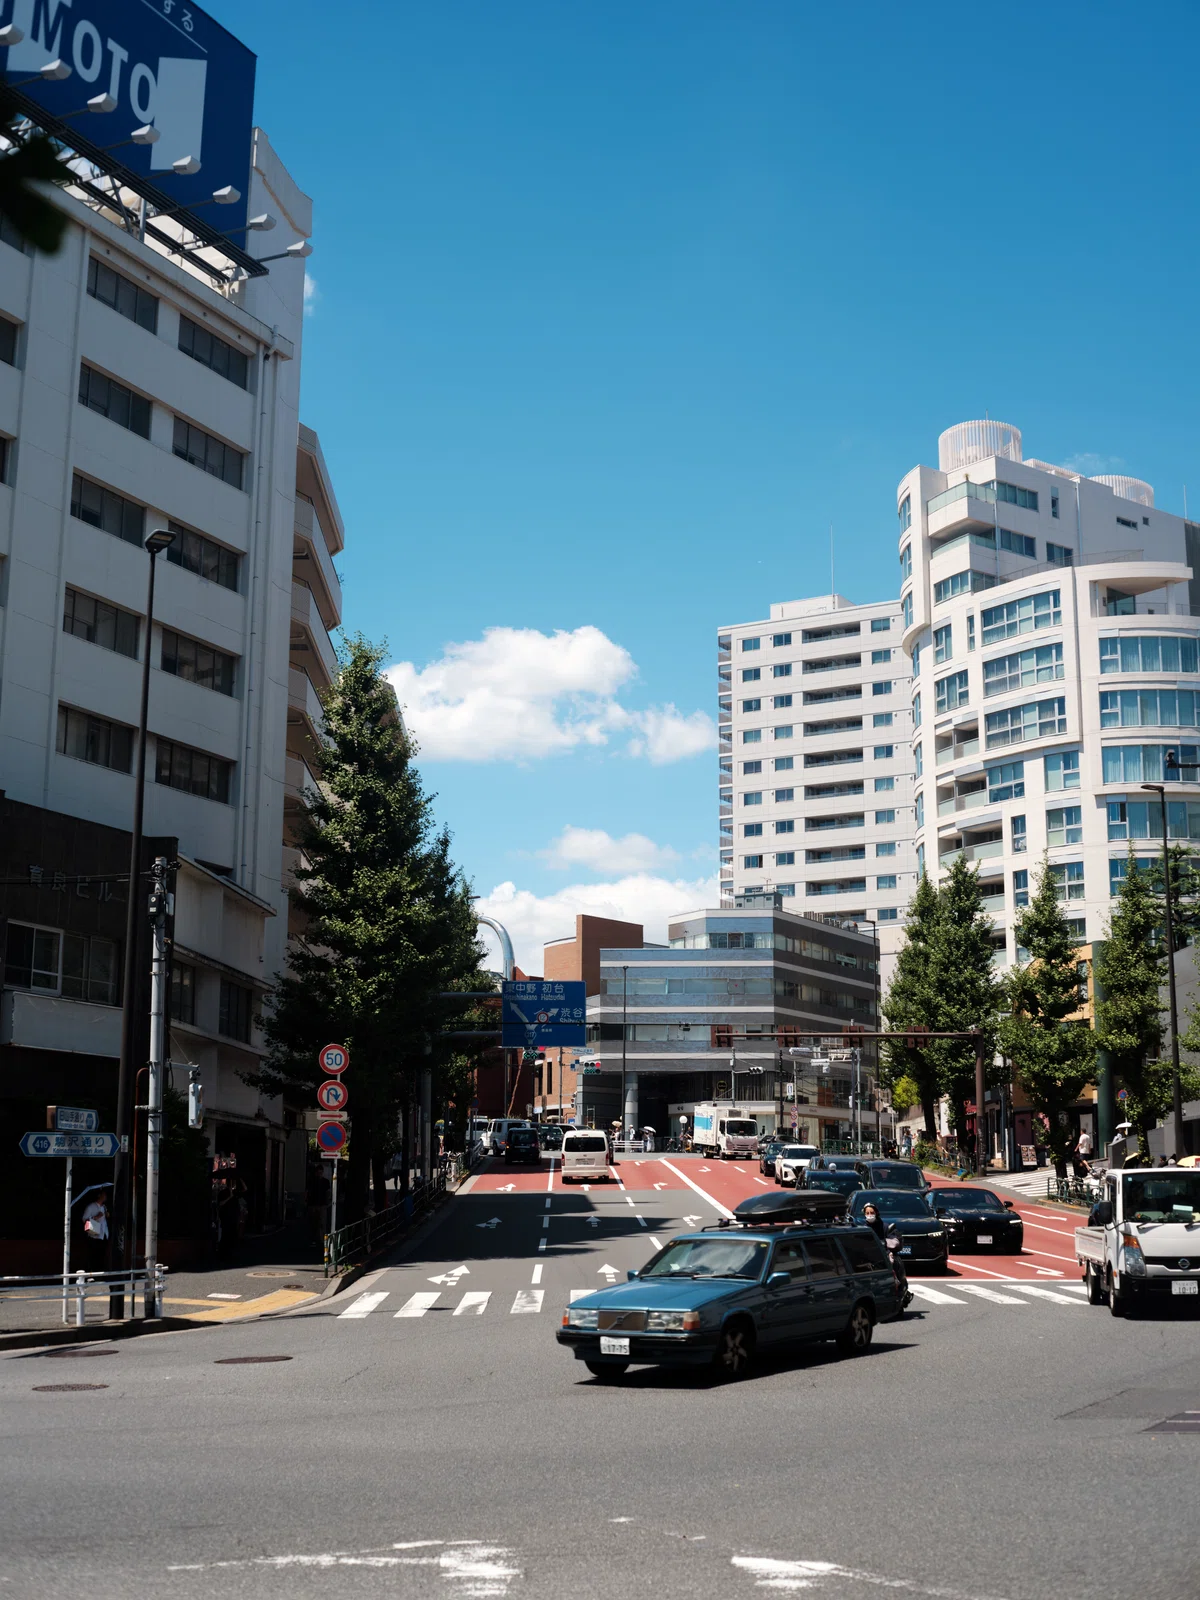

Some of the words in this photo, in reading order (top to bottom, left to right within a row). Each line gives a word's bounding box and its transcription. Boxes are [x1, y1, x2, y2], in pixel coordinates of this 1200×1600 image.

[0, 0, 158, 124] MOTO
[505, 983, 536, 993] 東中野
[542, 983, 564, 993] 初台
[560, 1008, 583, 1018] 渋谷
[326, 1053, 343, 1066] 50
[35, 1139, 48, 1147] 416
[54, 1136, 105, 1147] 駒沢通り
